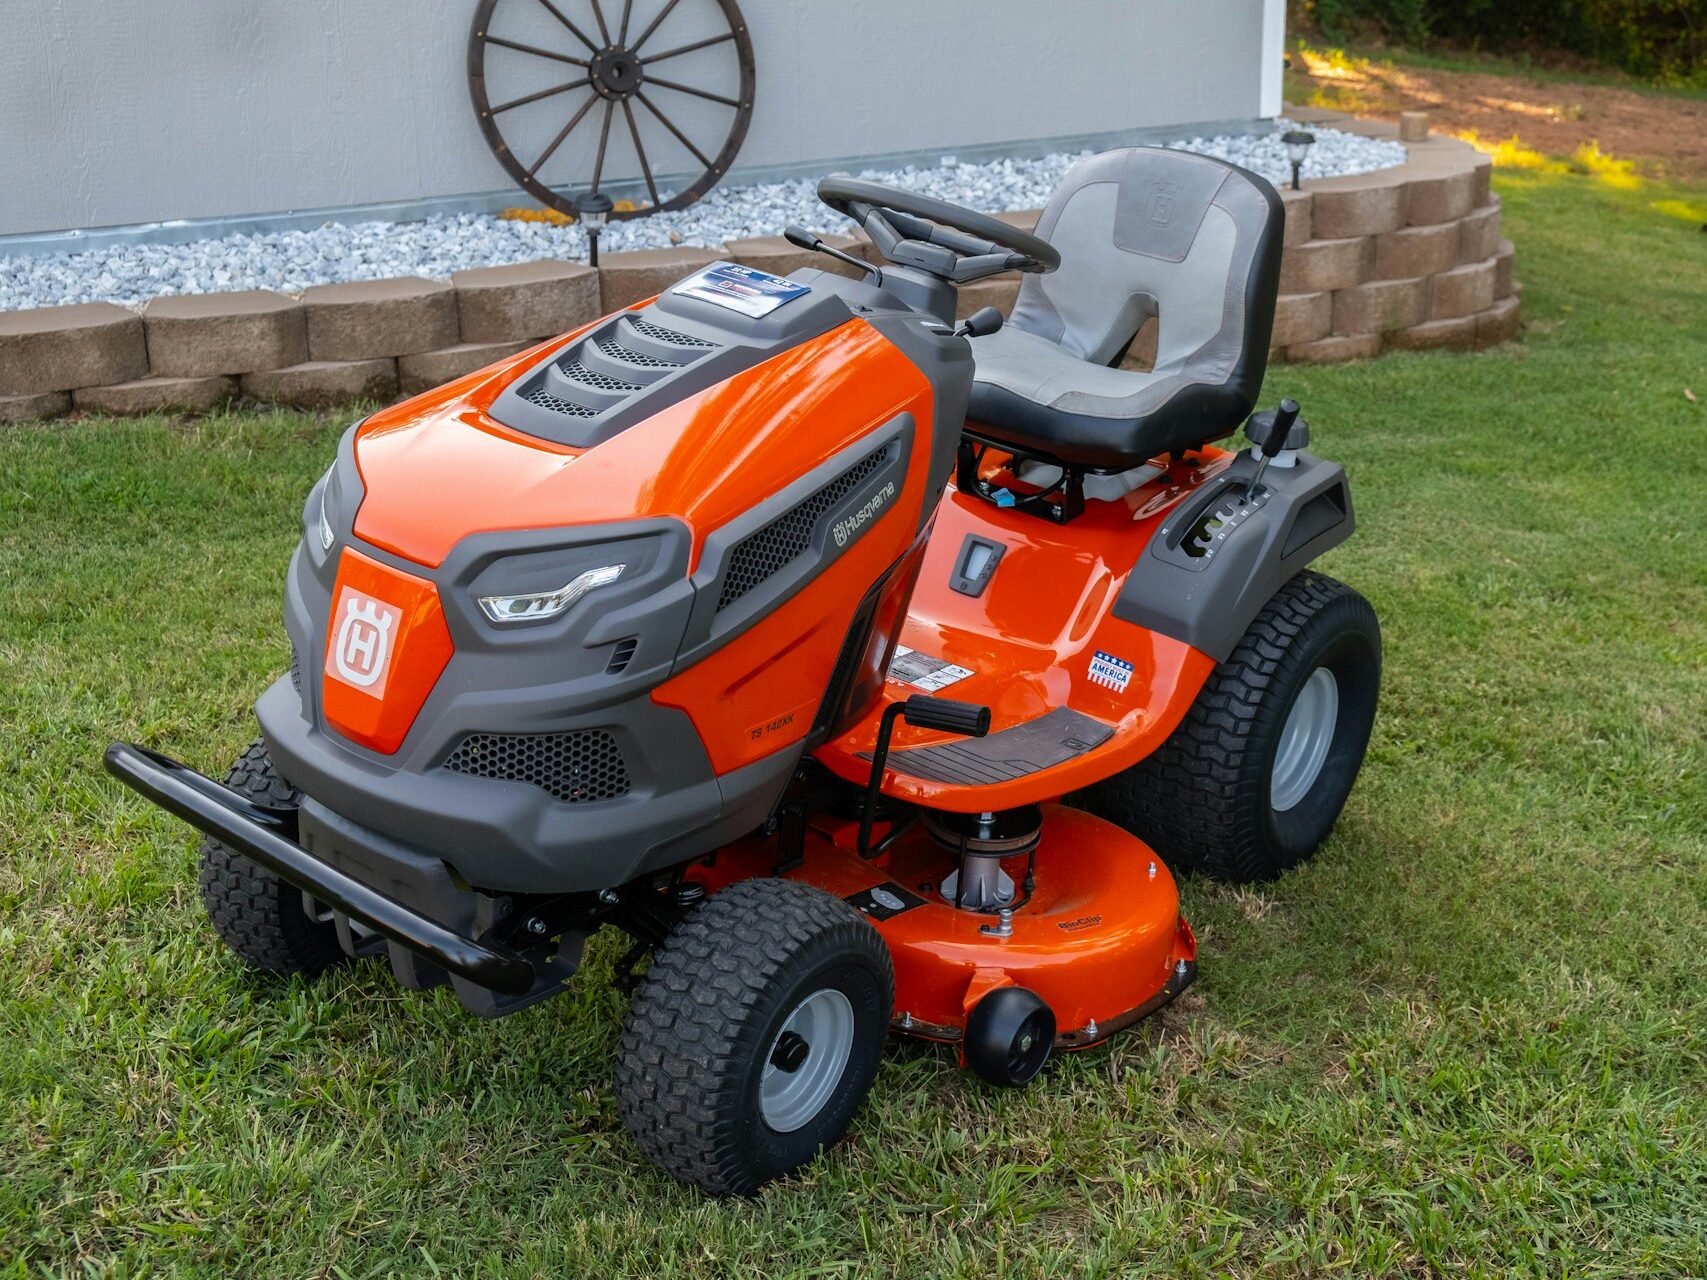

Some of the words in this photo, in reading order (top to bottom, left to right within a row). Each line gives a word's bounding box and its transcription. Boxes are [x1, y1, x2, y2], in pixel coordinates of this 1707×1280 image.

[844, 481, 895, 536] Husqvarna
[1091, 663, 1127, 683] AMERICA
[751, 727, 763, 740] TS
[765, 713, 795, 734] 142XK
[1058, 915, 1102, 929] BioClip
